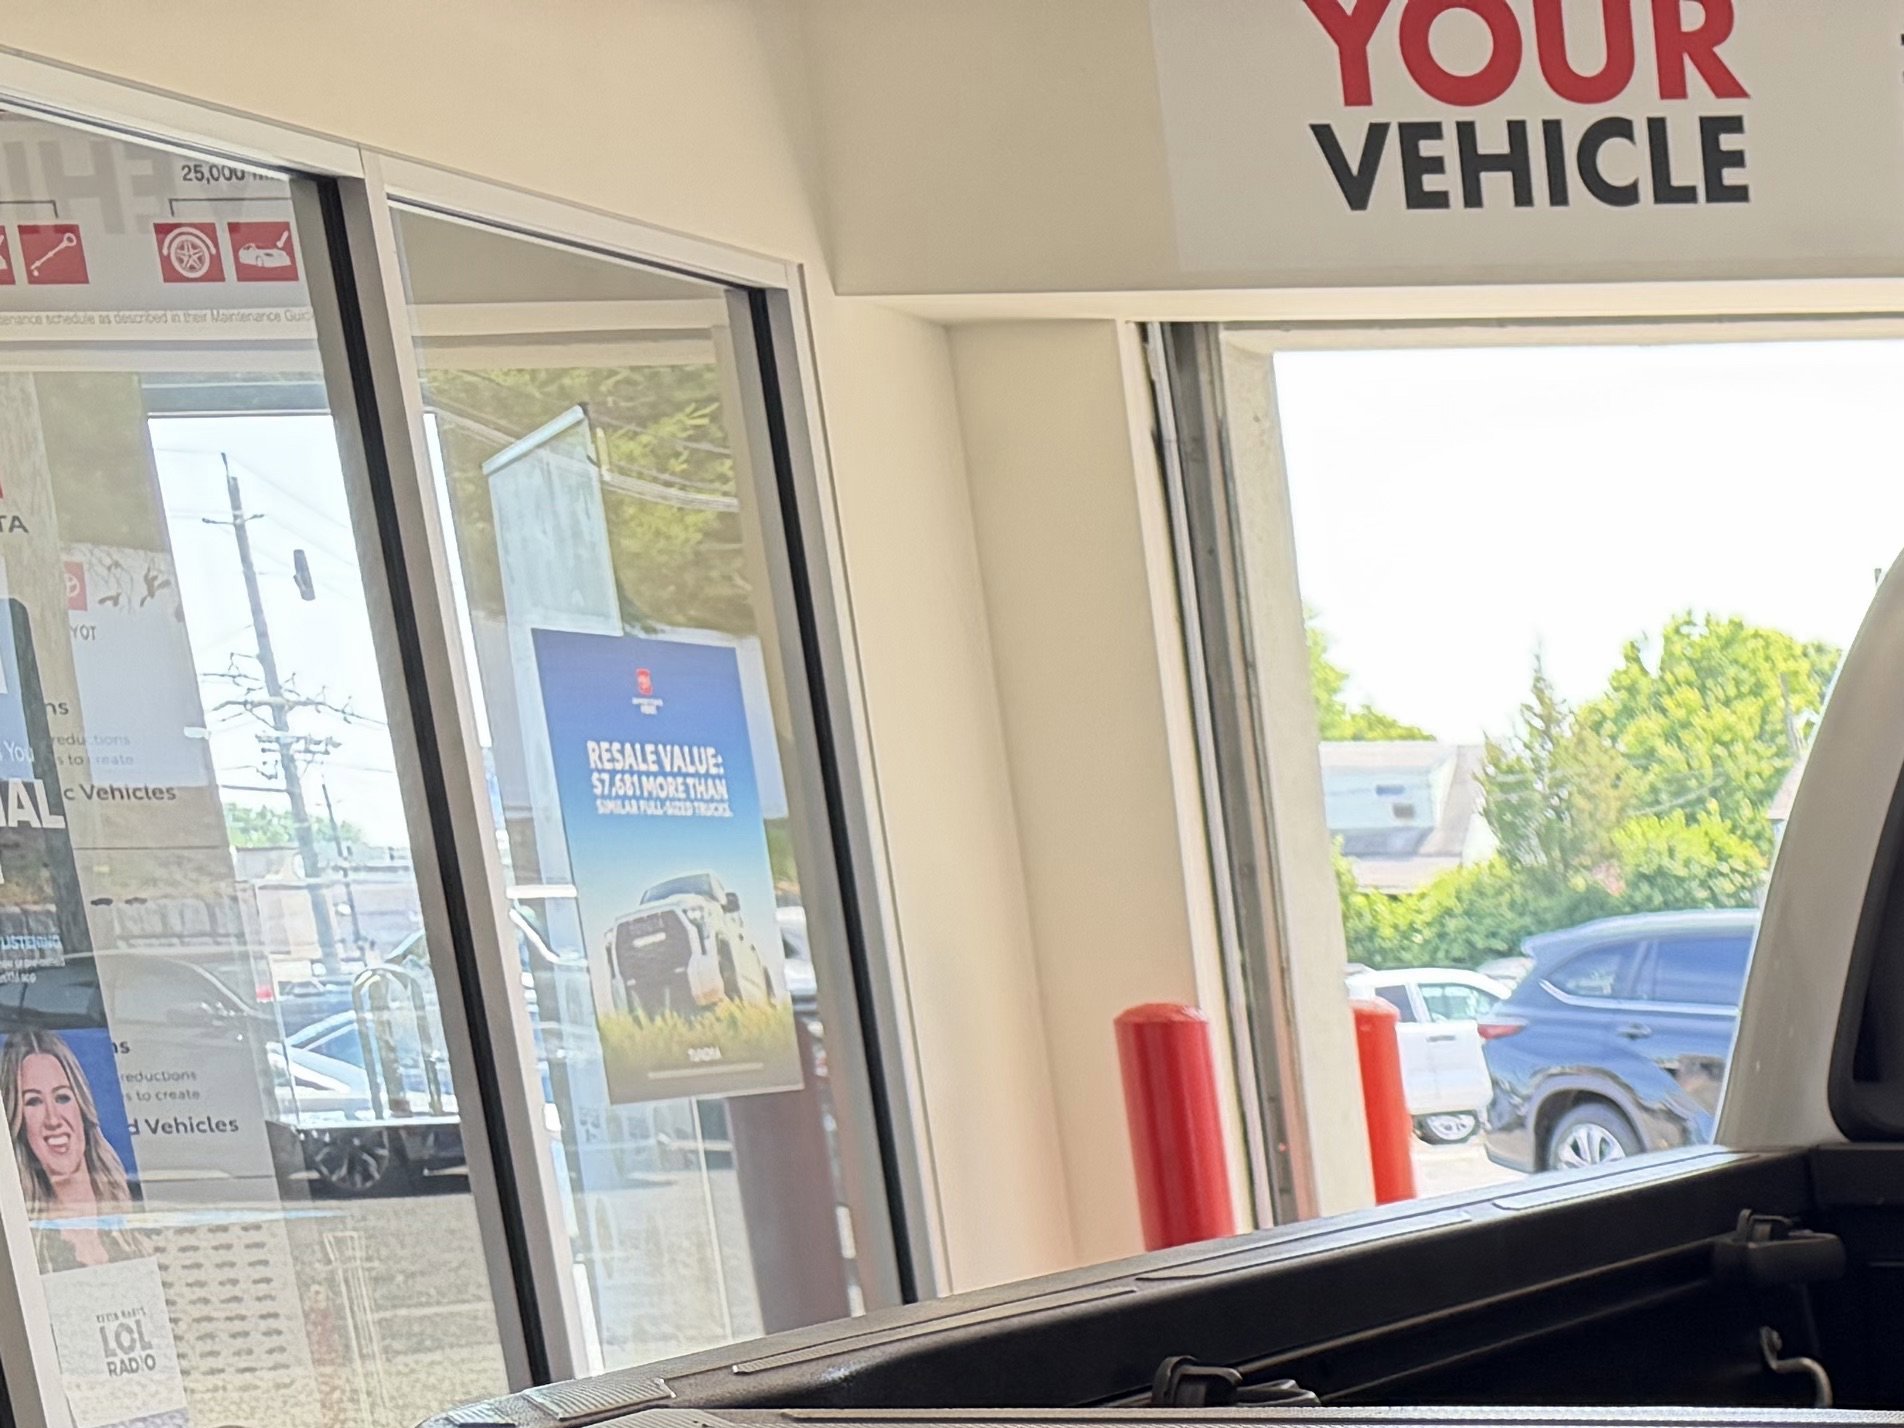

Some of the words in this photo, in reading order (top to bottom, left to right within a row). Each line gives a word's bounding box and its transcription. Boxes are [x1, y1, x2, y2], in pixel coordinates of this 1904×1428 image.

[1307, 0, 1751, 107] YOUR
[181, 164, 246, 185] 25,000
[1309, 115, 1751, 212] VEHICLE
[587, 740, 659, 772] RESALE
[658, 744, 724, 775] VALUE:
[79, 784, 177, 801] Vehicles
[591, 771, 641, 797] $7,681
[641, 775, 687, 799] MORE
[687, 777, 729, 800] THAN
[136, 1090, 151, 1101] to
[155, 1089, 201, 1101] create
[145, 1116, 239, 1135] Vehicles
[99, 1318, 153, 1359] LOL
